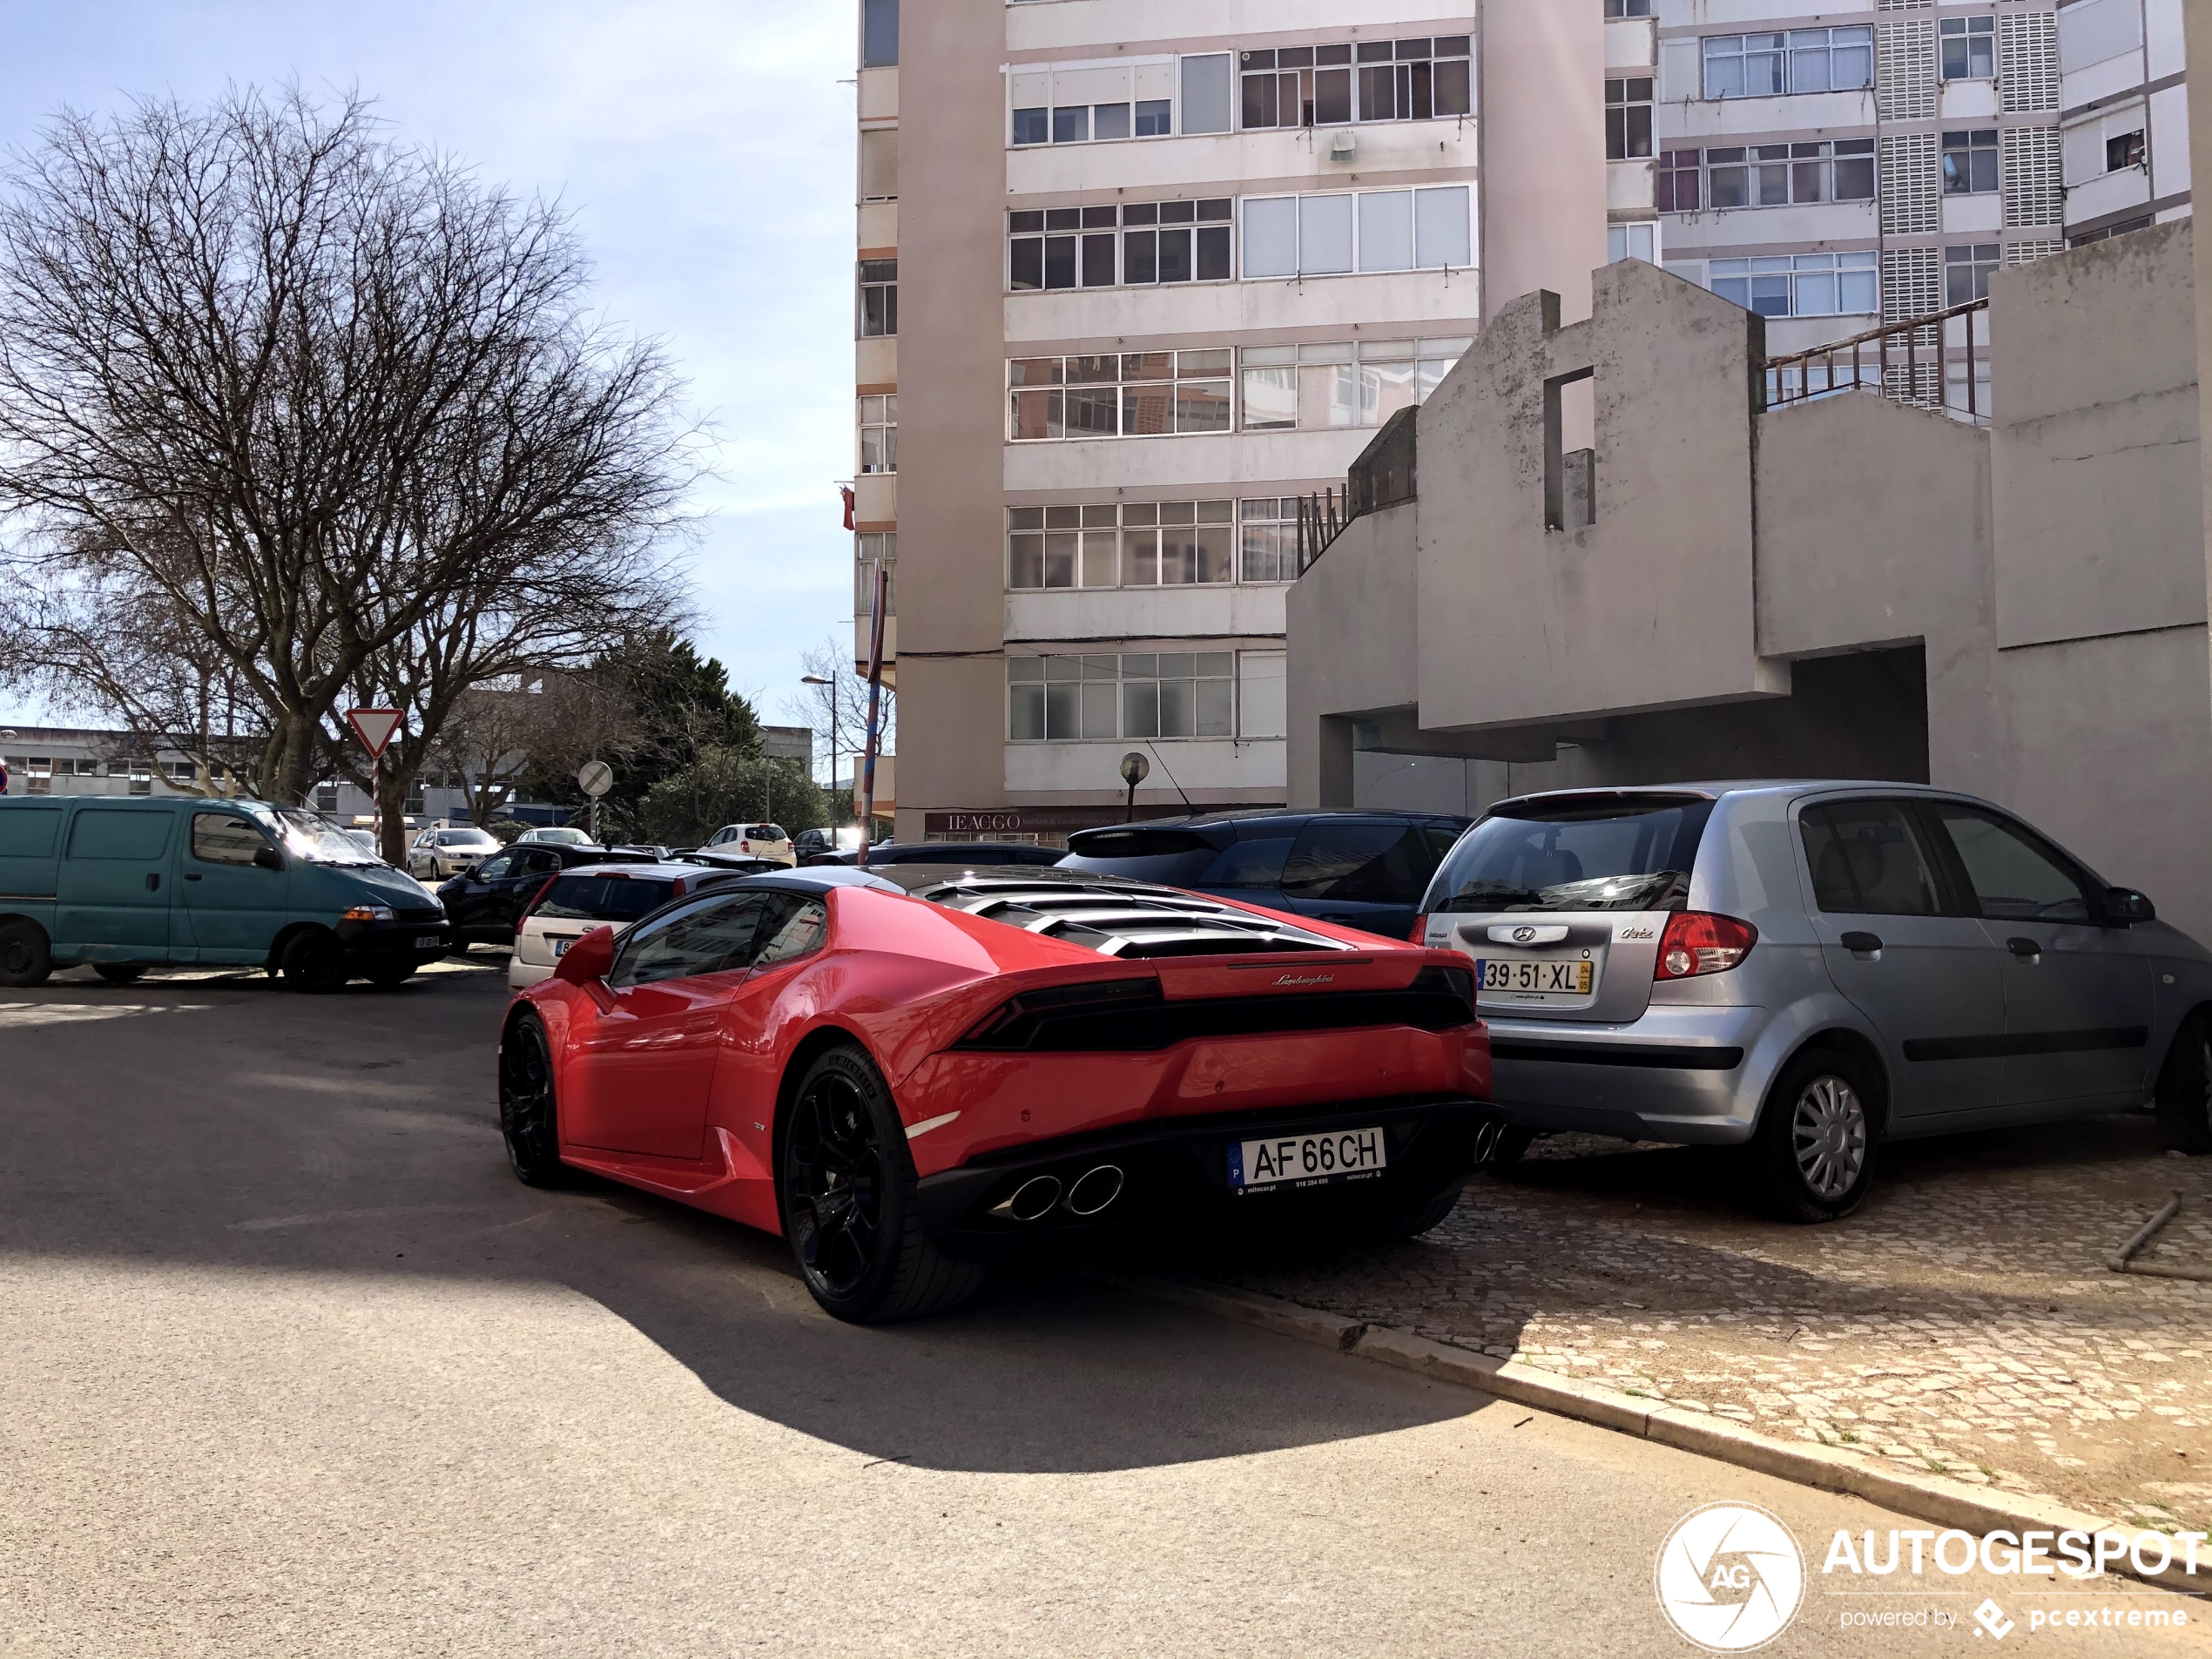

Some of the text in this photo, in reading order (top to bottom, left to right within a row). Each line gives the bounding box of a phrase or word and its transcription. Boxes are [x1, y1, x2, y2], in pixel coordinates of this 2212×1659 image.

[1581, 965, 1589, 974] 04
[1271, 974, 1335, 986] Lamborghini
[1579, 981, 1588, 990] 05
[1232, 1169, 1240, 1178] P
[1247, 1184, 1277, 1194] mitocar.pt
[1346, 1171, 1373, 1180] mitocar.pt
